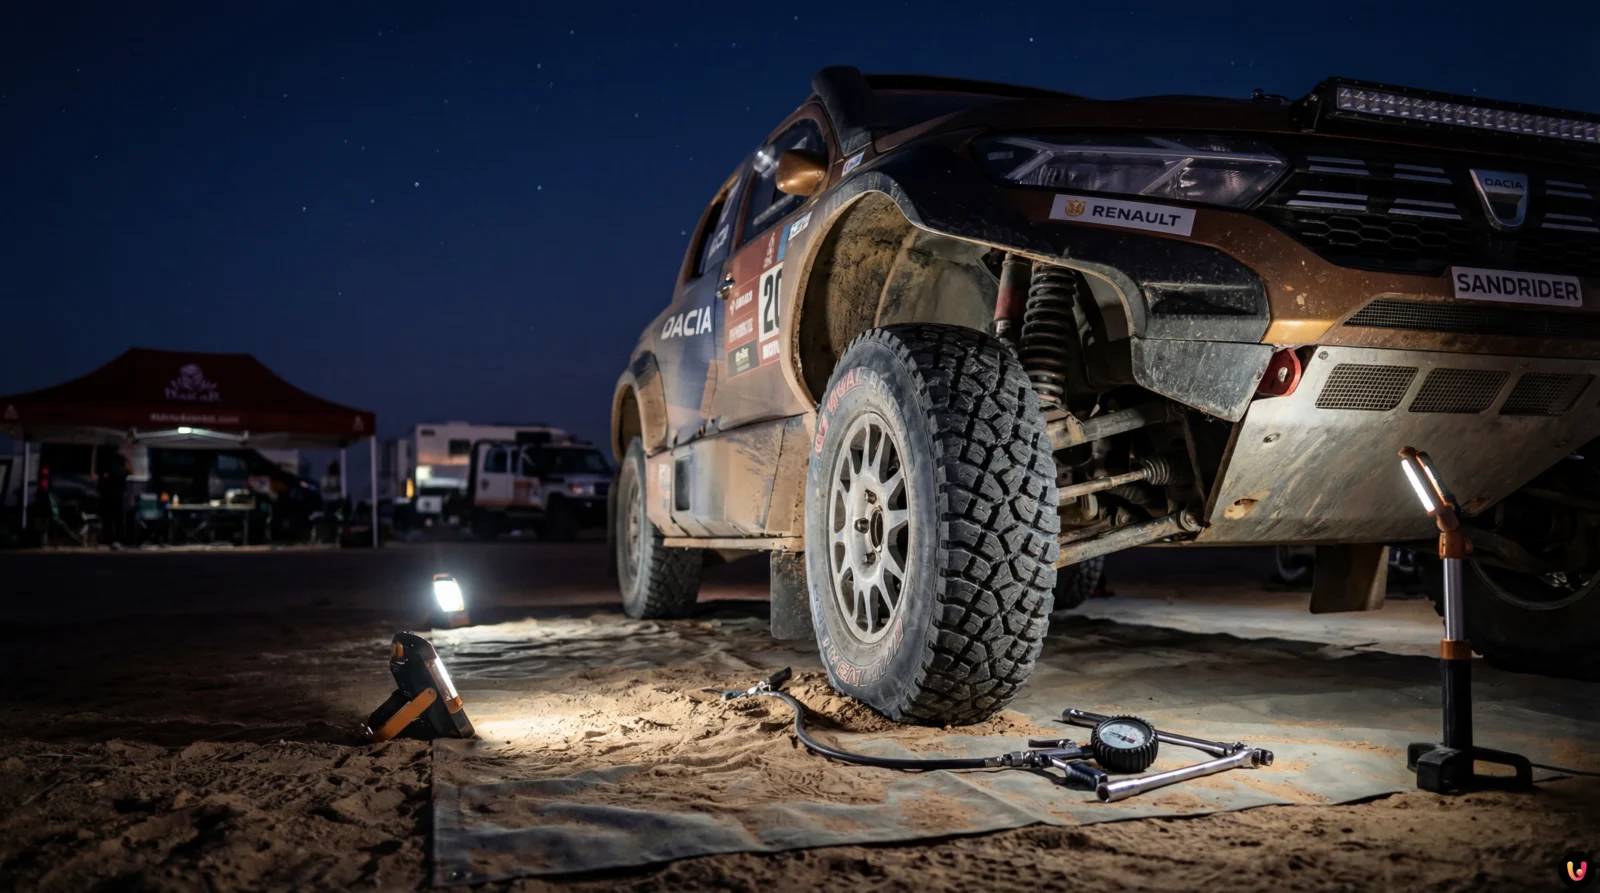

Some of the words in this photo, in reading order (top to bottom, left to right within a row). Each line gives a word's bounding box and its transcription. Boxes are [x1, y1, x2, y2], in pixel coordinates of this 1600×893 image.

[1485, 178, 1524, 189] DACIA
[1092, 205, 1181, 227] RENAULT
[1457, 273, 1579, 300] SANDRIDER
[661, 306, 712, 340] DACIA
